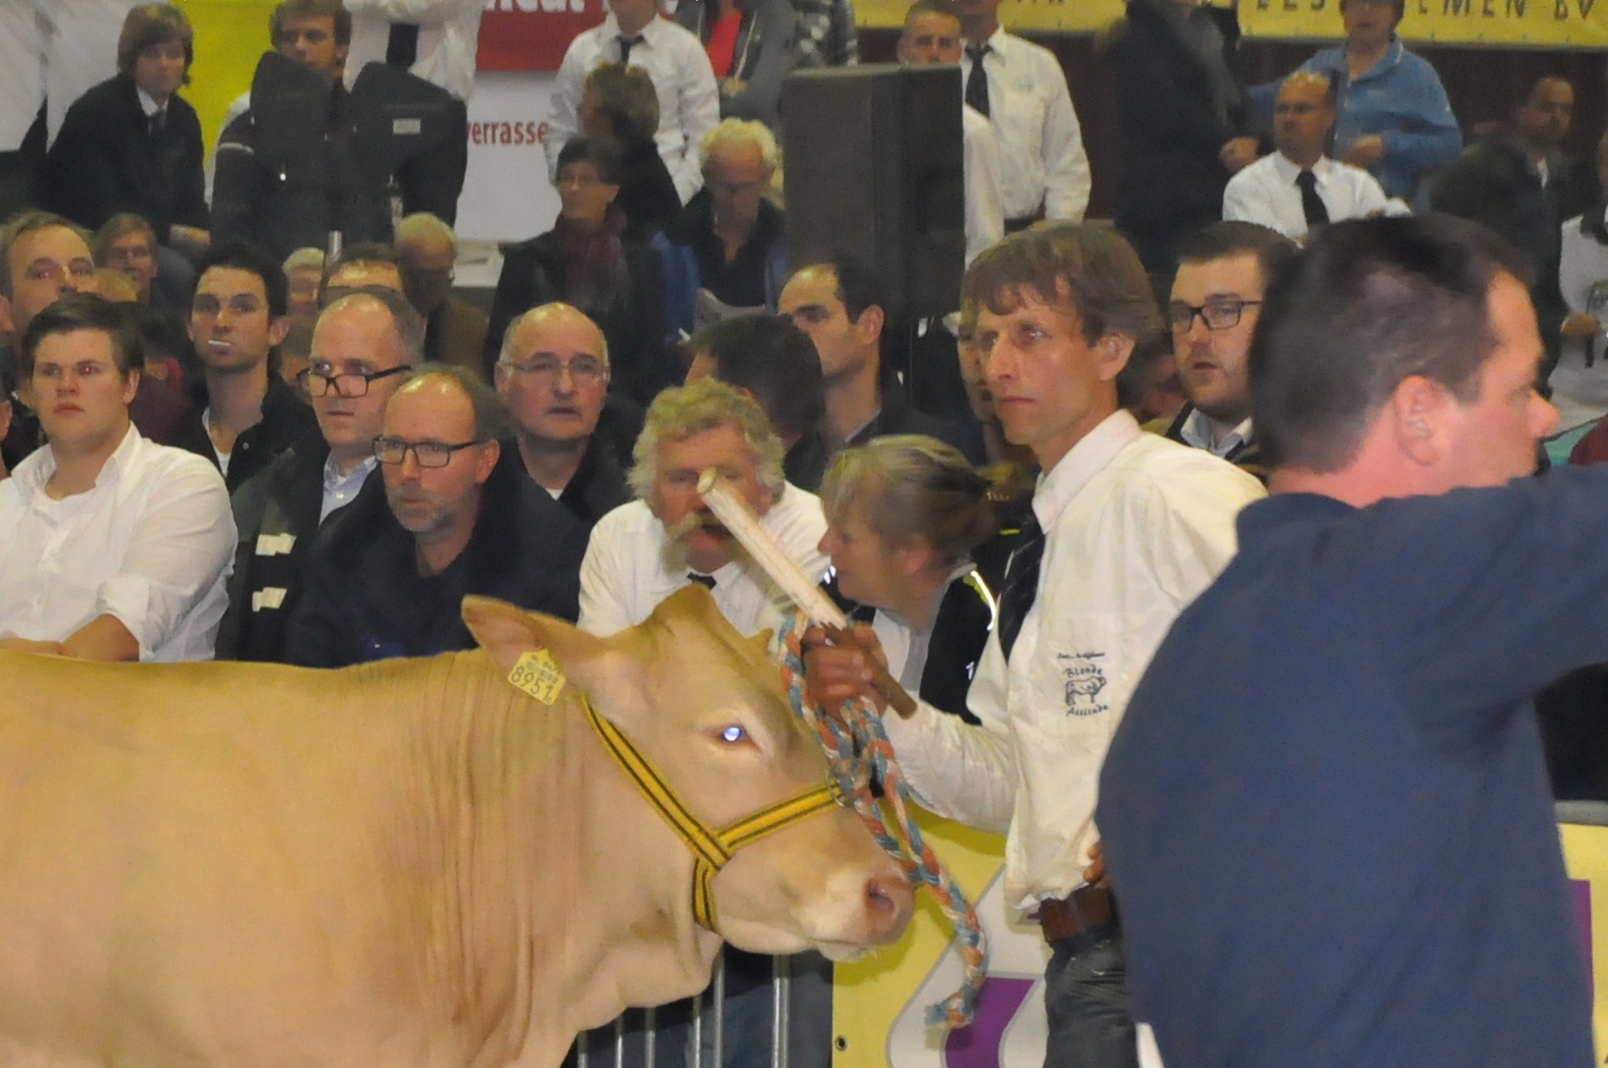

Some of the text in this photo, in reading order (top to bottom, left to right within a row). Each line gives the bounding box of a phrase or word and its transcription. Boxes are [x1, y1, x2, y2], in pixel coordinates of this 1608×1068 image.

[468, 121, 549, 145] errasse
[511, 665, 554, 701] 8951
[1063, 664, 1102, 678] Blonde
